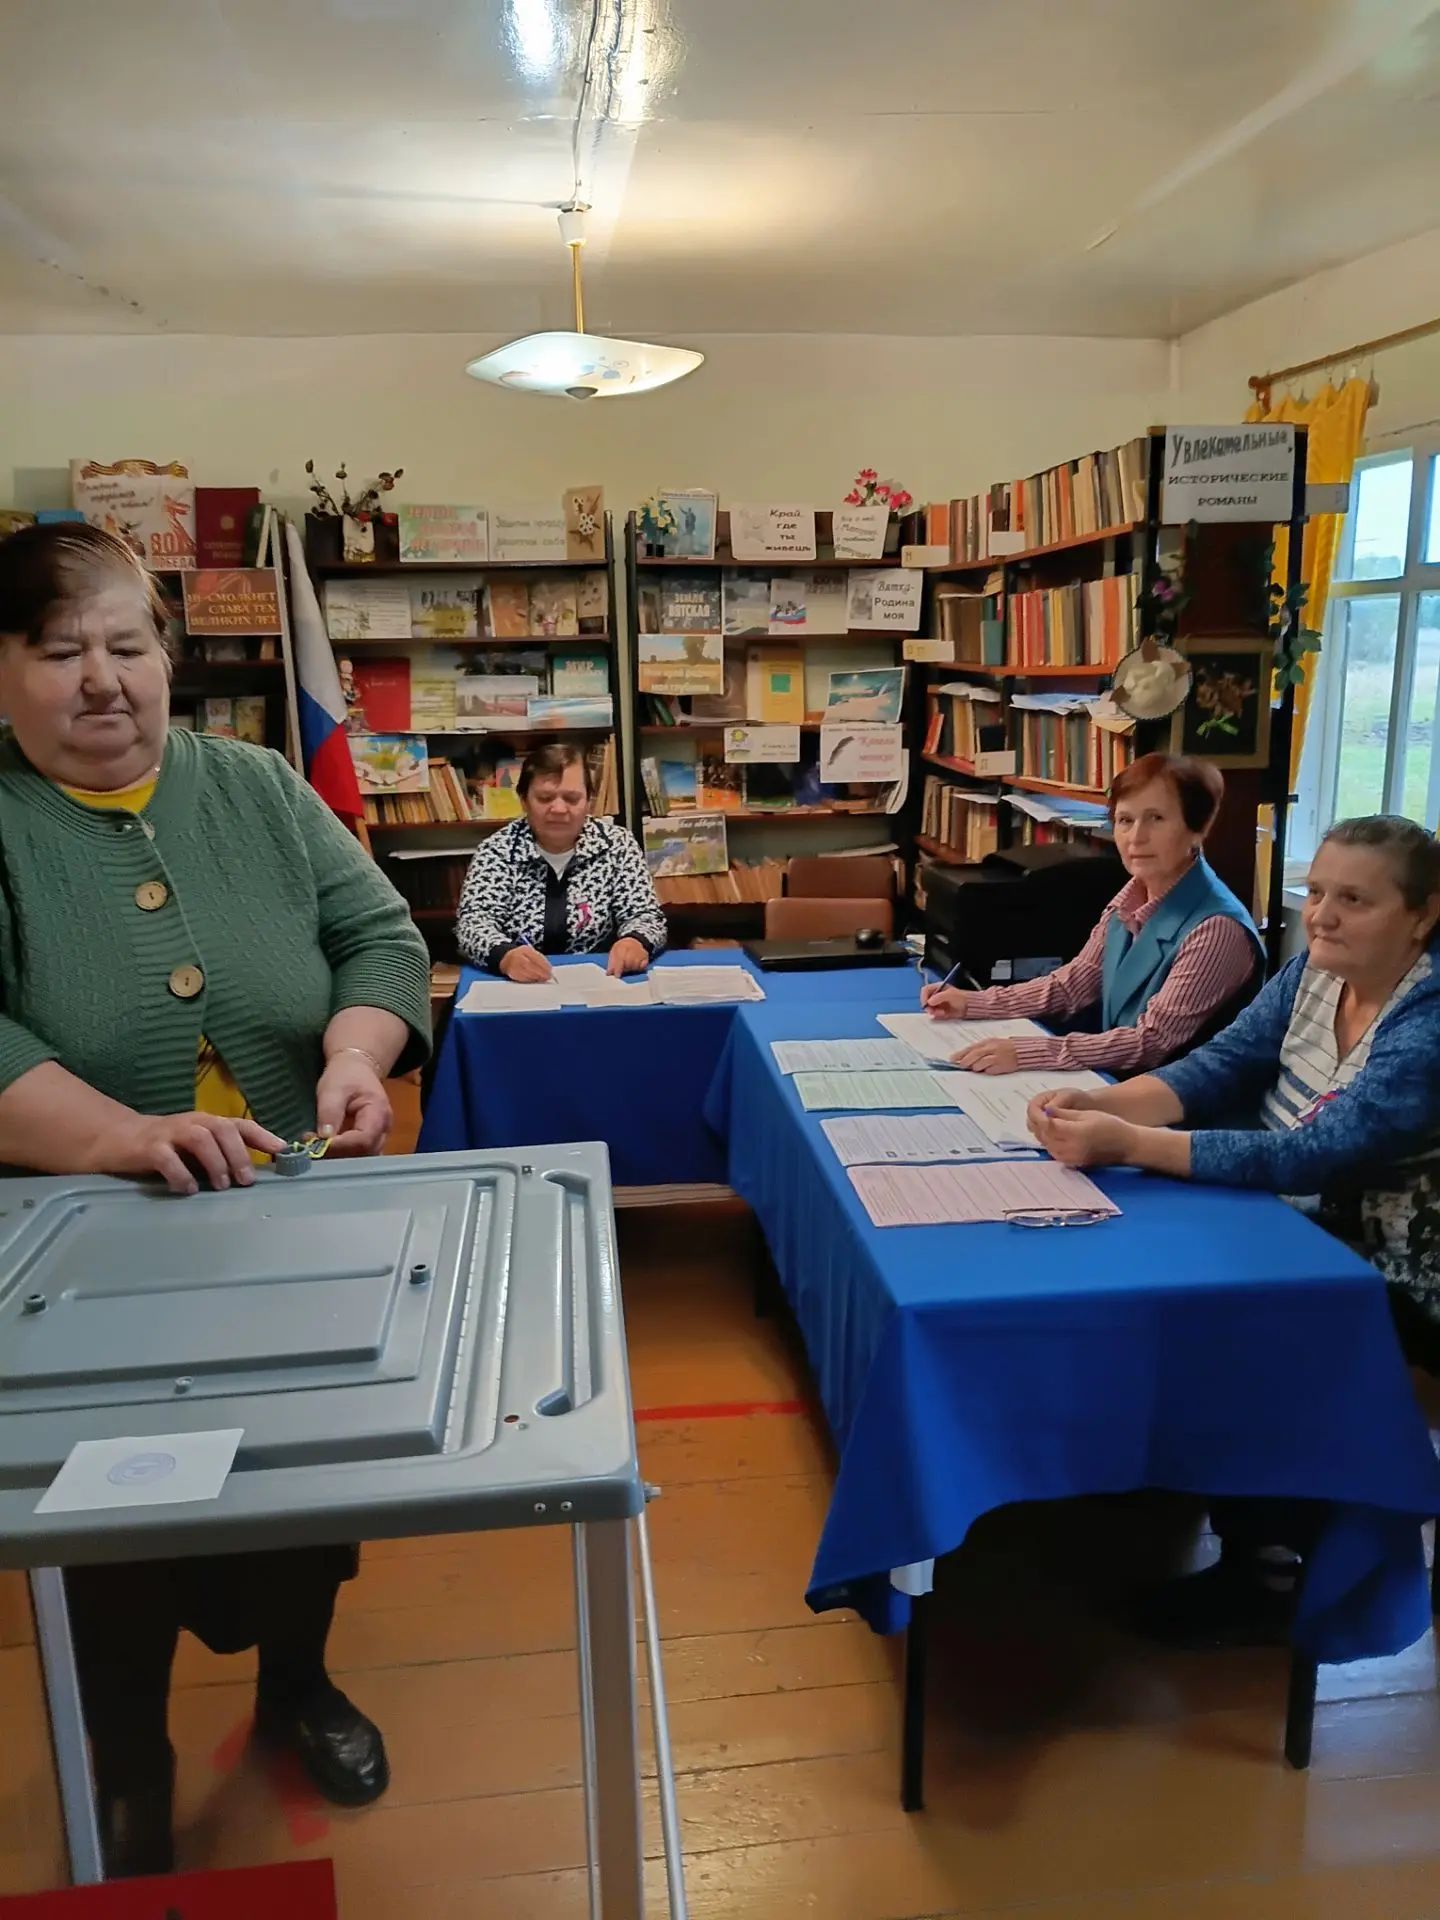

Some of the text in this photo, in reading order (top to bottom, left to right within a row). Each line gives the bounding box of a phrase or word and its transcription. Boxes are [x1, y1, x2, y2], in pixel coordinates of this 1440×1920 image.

[1168, 472, 1289, 485] ИСТОРИЧЕСКИЕ
[1197, 496, 1257, 507] РОМАНЫ
[874, 597, 915, 608] Родина
[883, 612, 905, 620] моя
